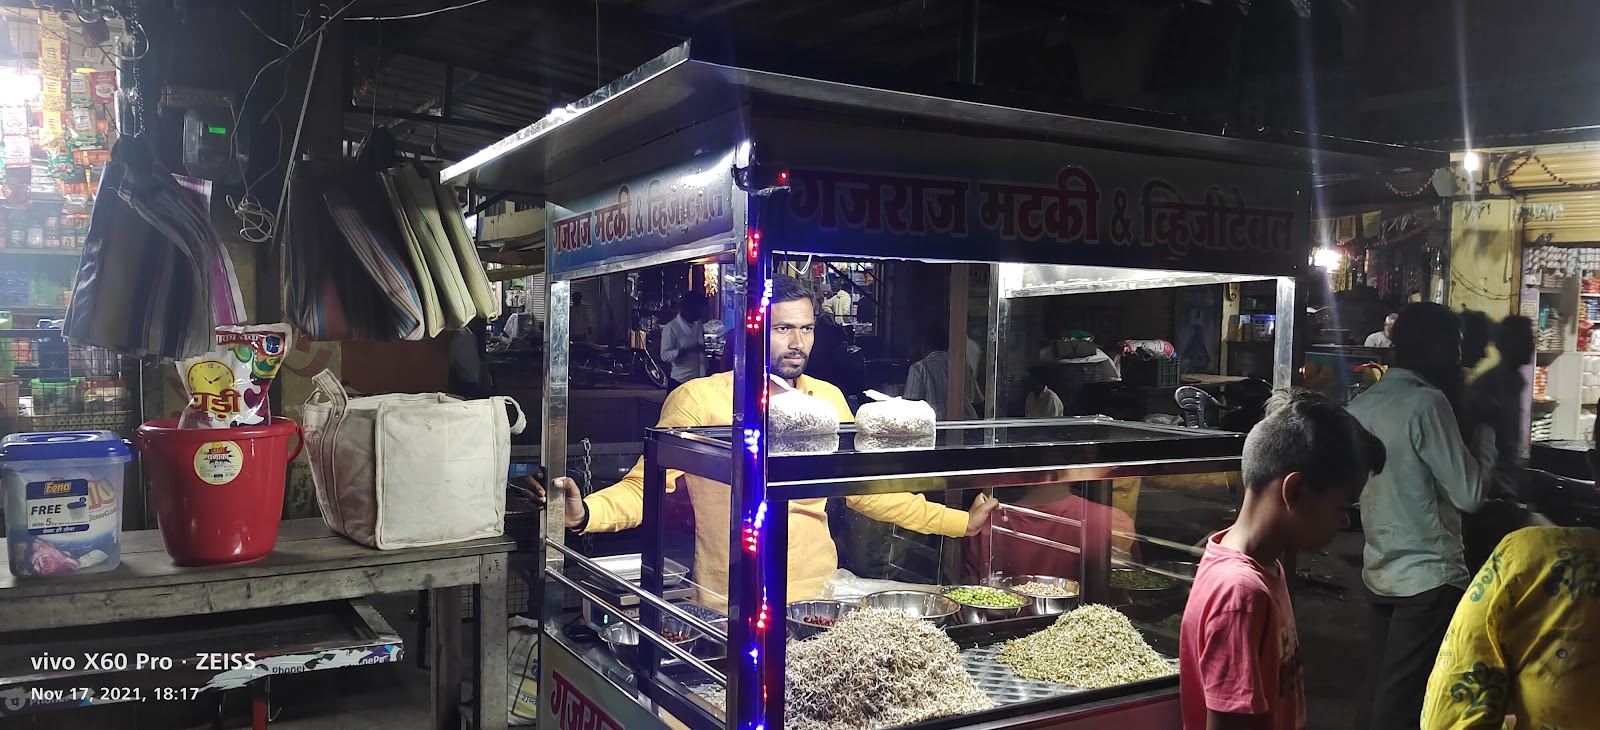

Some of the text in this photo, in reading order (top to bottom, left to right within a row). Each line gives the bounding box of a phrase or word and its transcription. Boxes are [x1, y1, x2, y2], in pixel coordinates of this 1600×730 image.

[553, 212, 593, 254] गजराज
[594, 184, 633, 245] मटकी
[635, 195, 644, 237] &
[790, 167, 969, 235] गजराज
[979, 166, 1101, 242] मटकी
[1111, 187, 1134, 245] &
[31, 504, 62, 516] FREE
